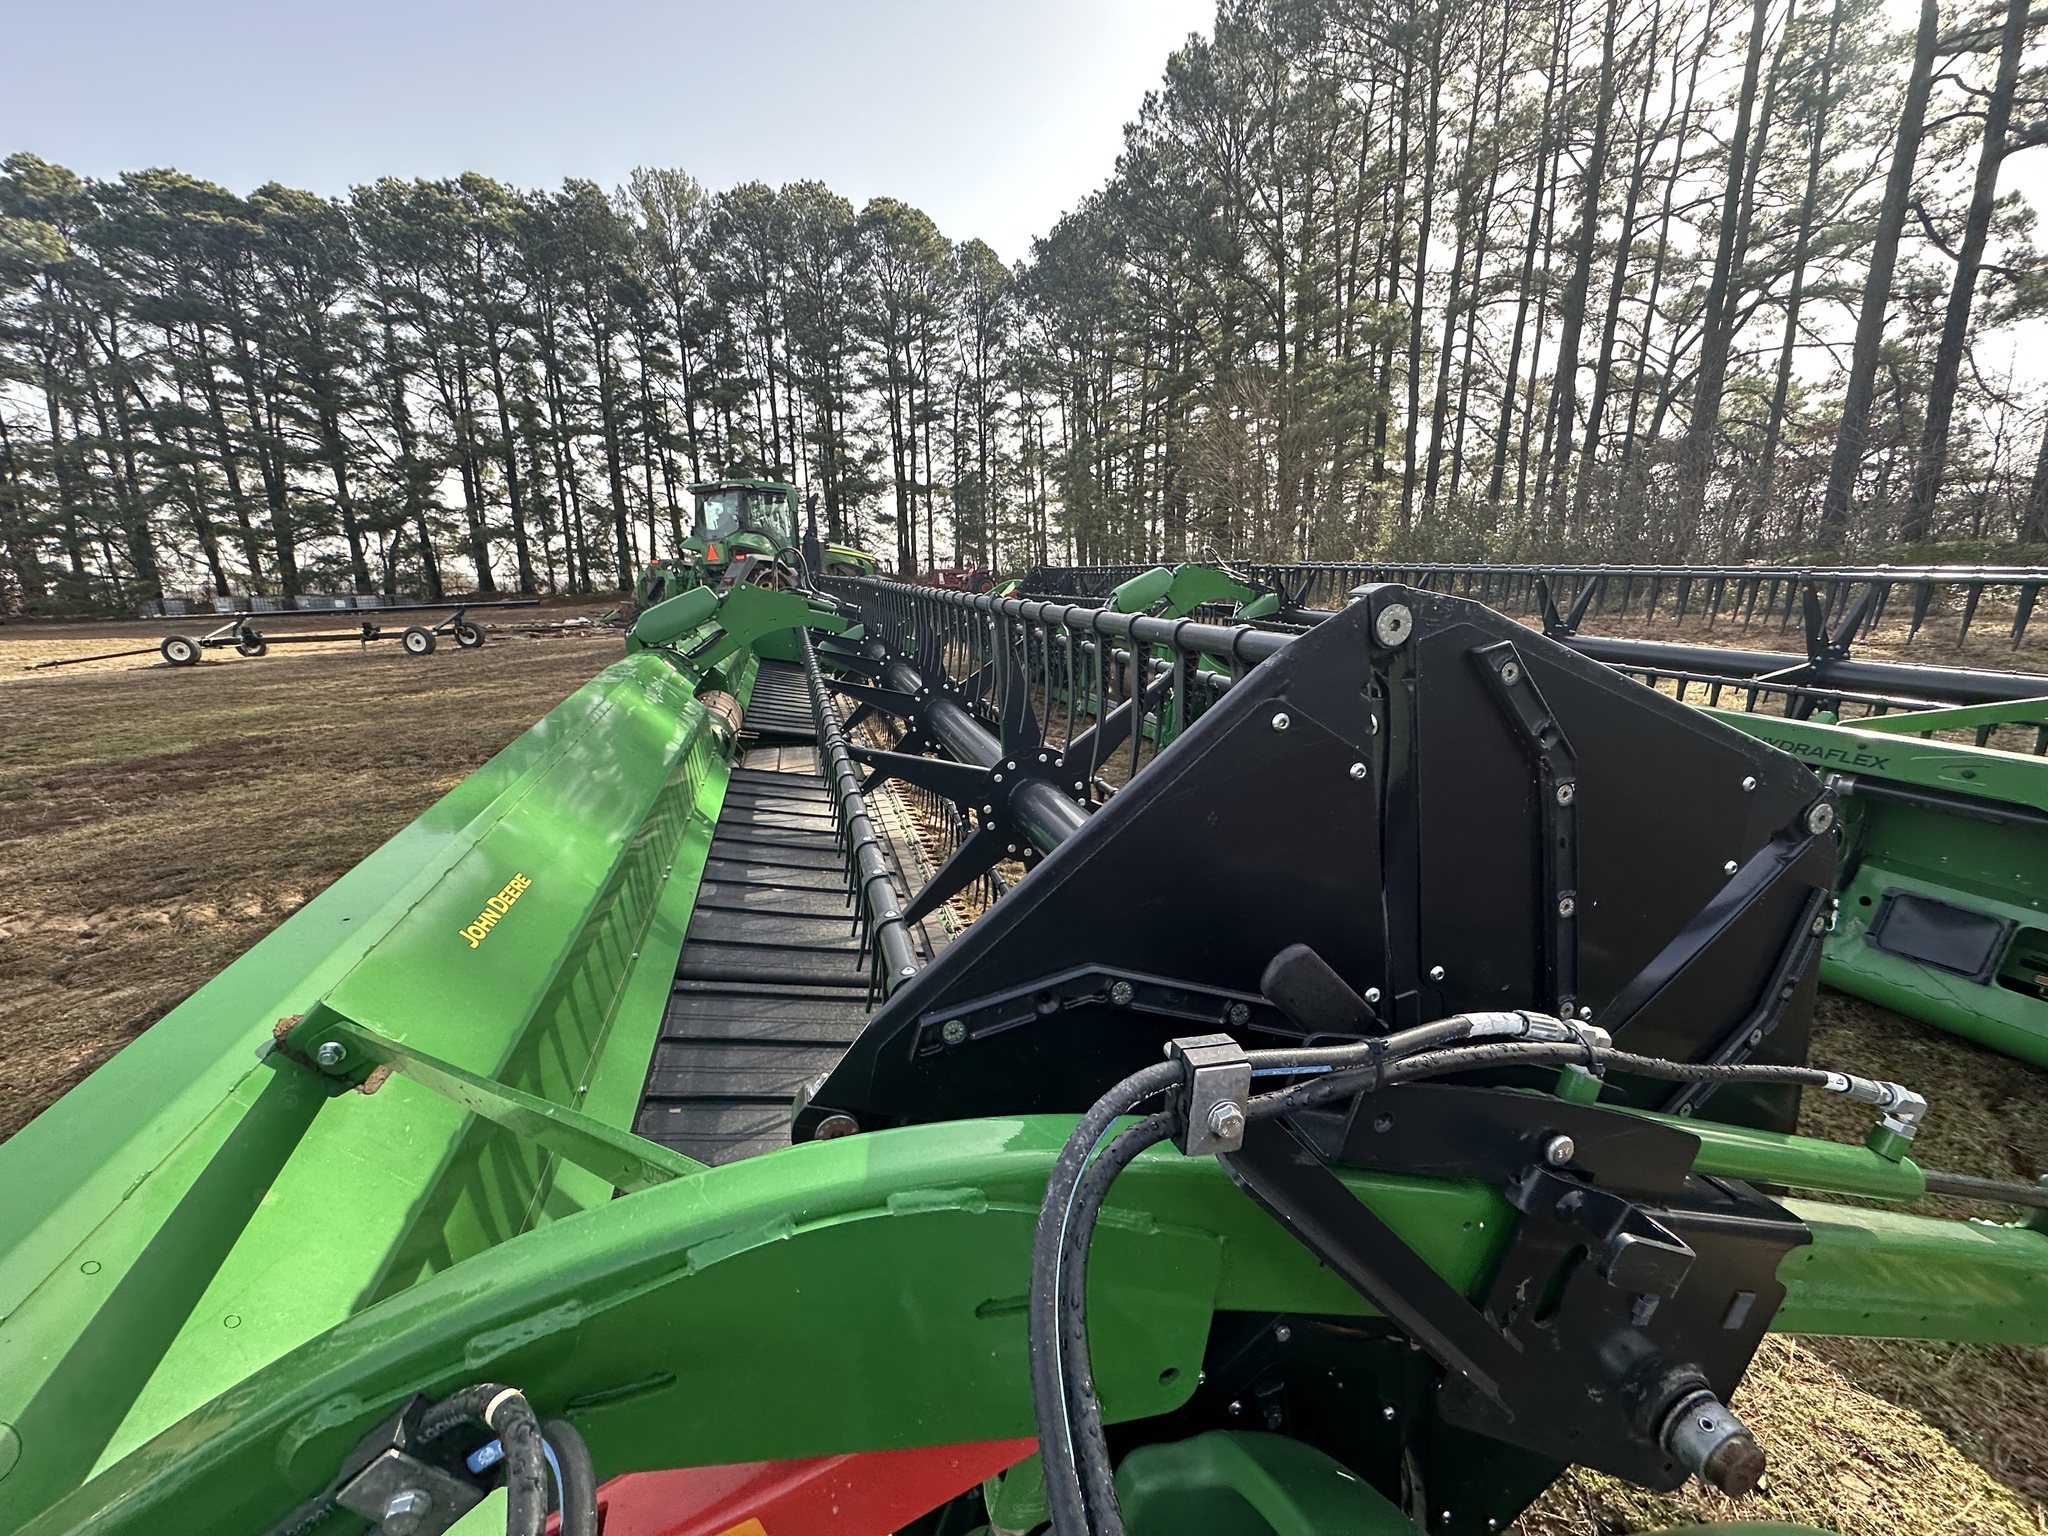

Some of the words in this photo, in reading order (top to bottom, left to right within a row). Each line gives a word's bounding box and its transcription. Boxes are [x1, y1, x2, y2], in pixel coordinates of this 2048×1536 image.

[1755, 736, 1890, 770] YDRAFLEX
[458, 907, 503, 949] JOHN
[486, 872, 533, 914] DEERE
